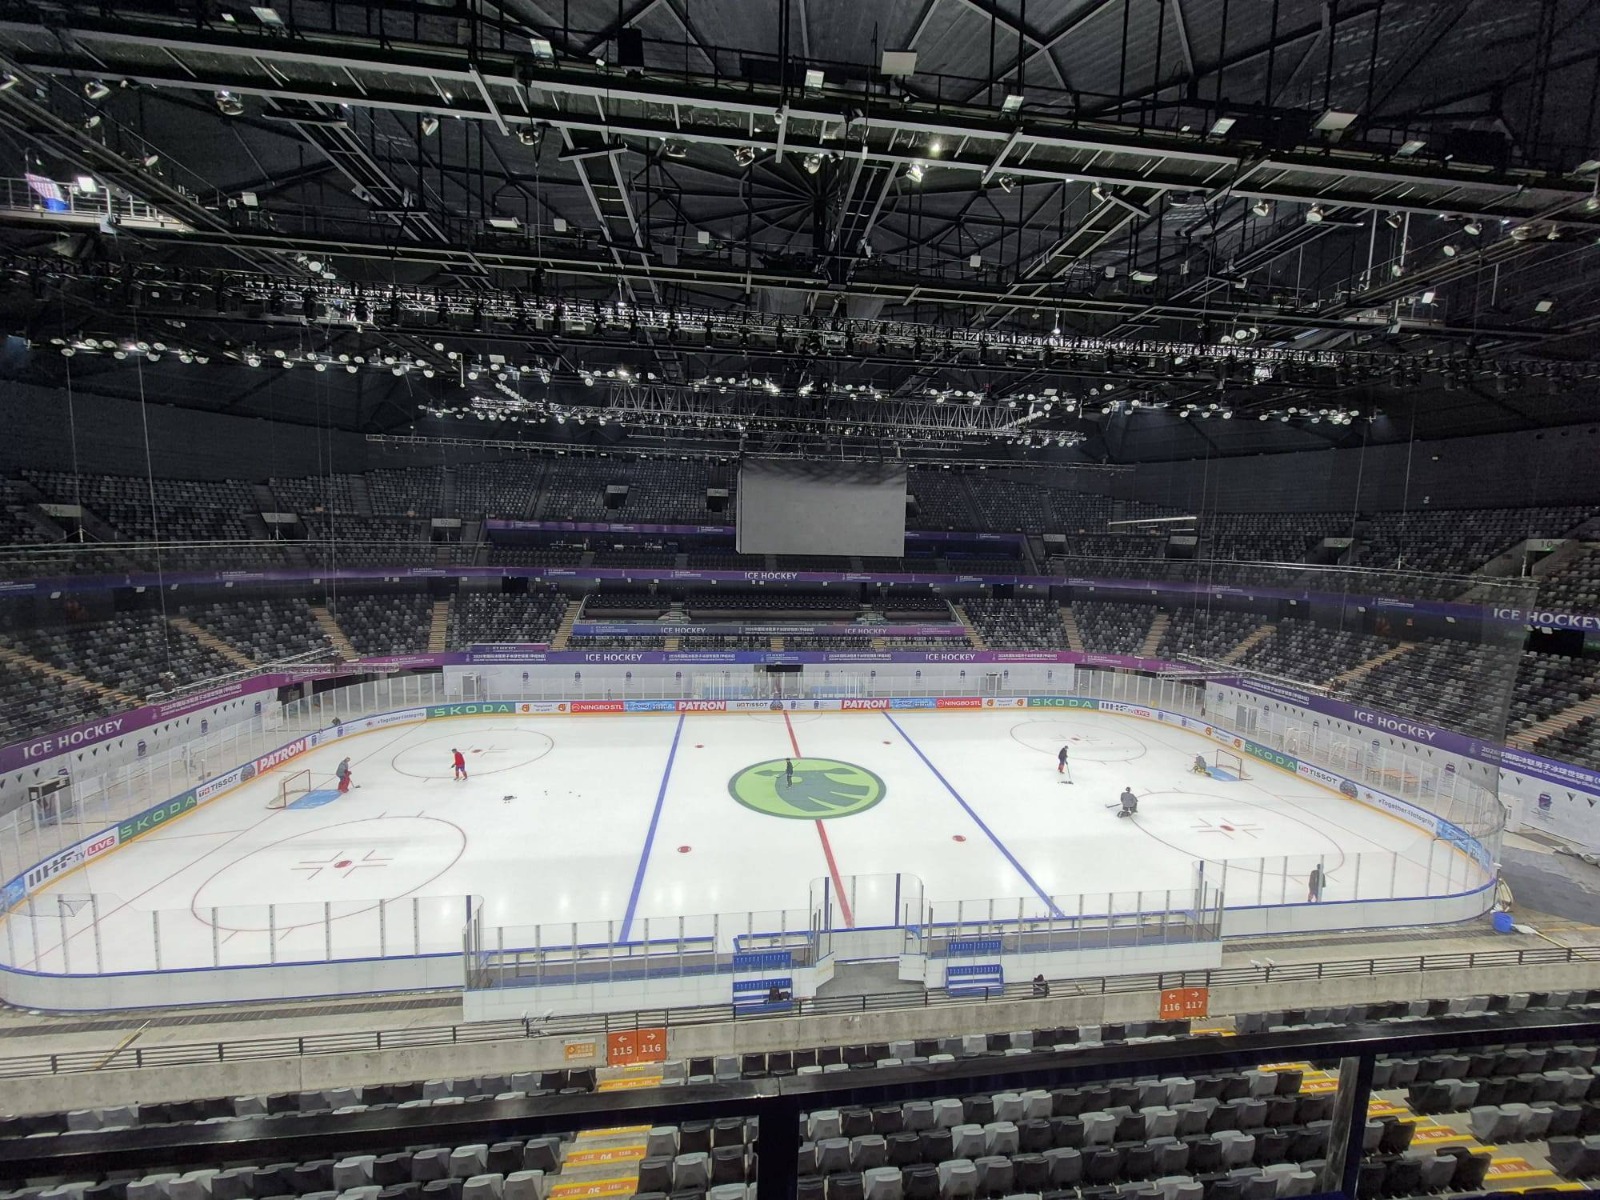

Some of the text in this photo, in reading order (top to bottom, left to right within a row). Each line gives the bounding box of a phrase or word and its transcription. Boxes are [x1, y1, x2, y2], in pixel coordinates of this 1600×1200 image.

[1493, 607, 1521, 620] ICE
[585, 653, 643, 662] ICE HOCKEY
[925, 653, 976, 661] ICE HOCKEY
[678, 701, 725, 711] PATRON
[843, 699, 887, 709] PATRON
[1354, 710, 1436, 741] ICE HOCKEY
[22, 718, 123, 760] ICE HOCKEY
[259, 739, 304, 771] PATRON
[1310, 768, 1338, 784] TISSOT
[210, 773, 238, 791] TISSOT
[88, 837, 115, 856] LIVE
[1164, 1003, 1180, 1012] 116
[1186, 1001, 1203, 1009] 117
[613, 1046, 633, 1056] 115
[641, 1044, 661, 1053] 116
